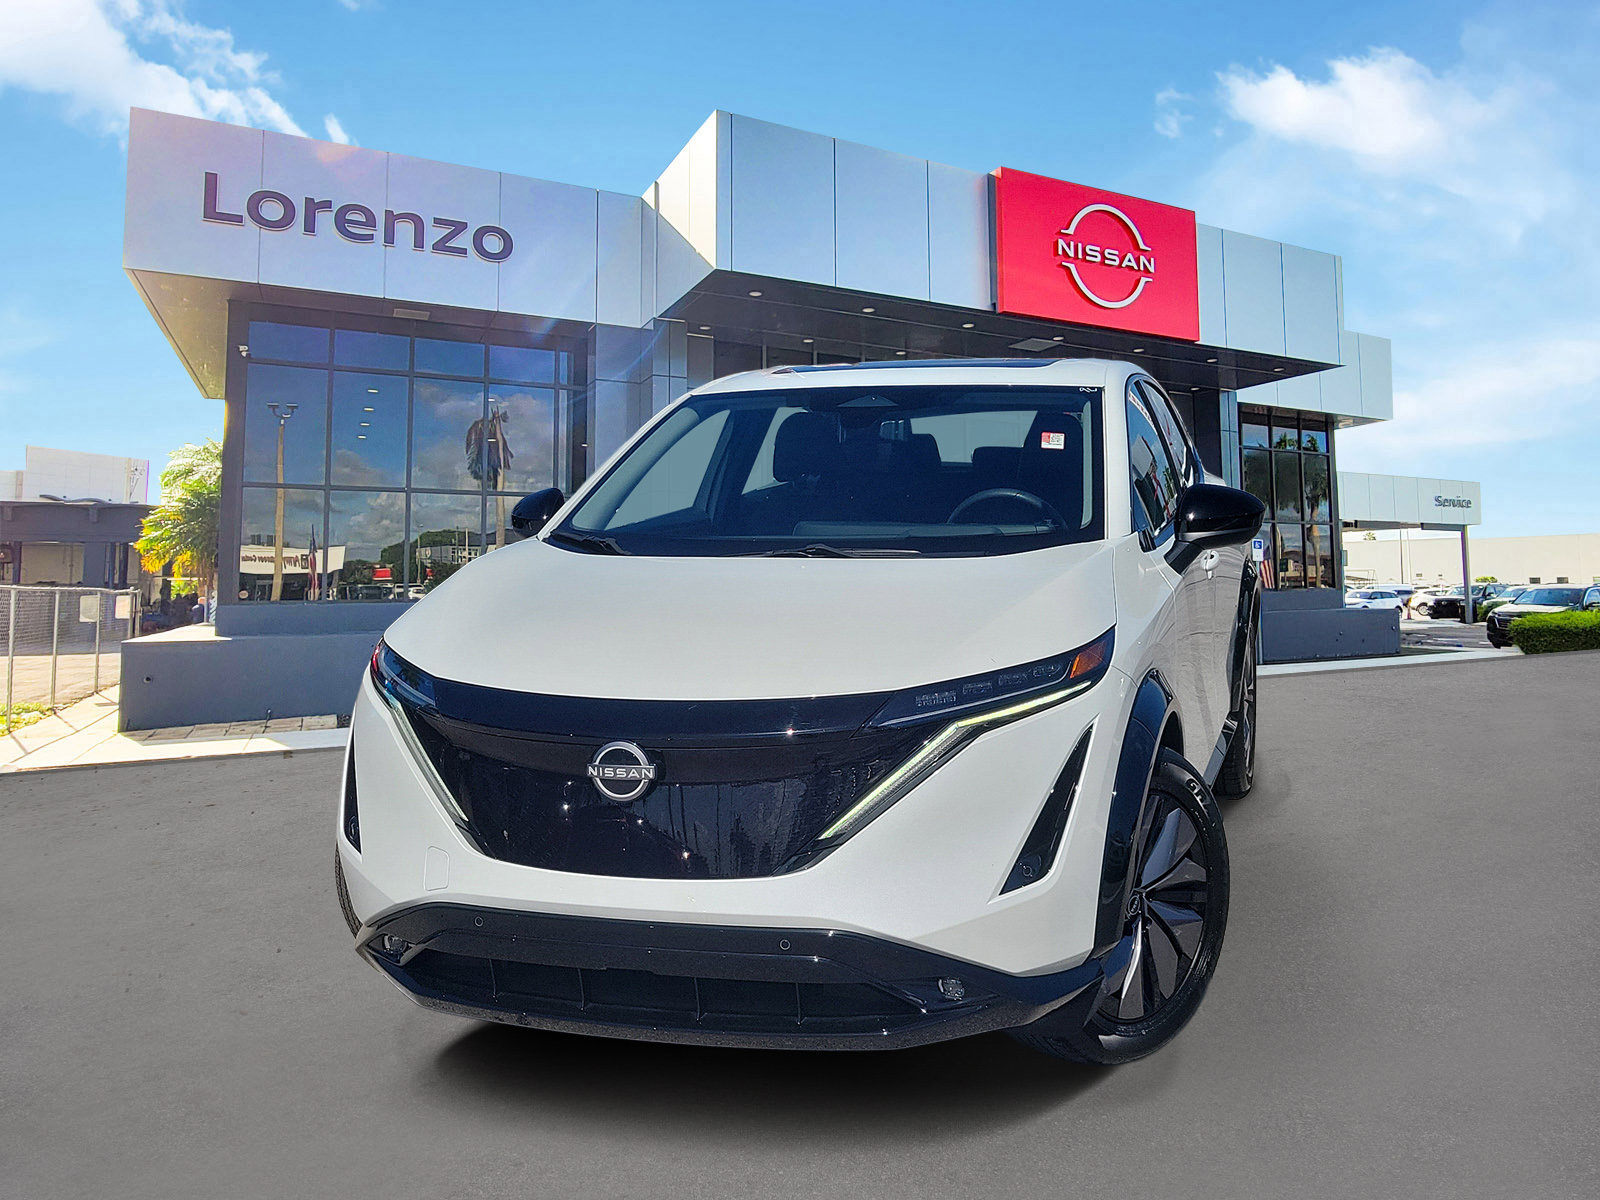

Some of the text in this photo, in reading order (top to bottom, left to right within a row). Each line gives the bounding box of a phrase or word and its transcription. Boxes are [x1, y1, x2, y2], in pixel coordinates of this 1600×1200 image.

[203, 170, 514, 262] Lorenzo
[1057, 238, 1155, 273] NISSAN
[1434, 495, 1472, 508] Service
[588, 766, 653, 779] NISSAN
